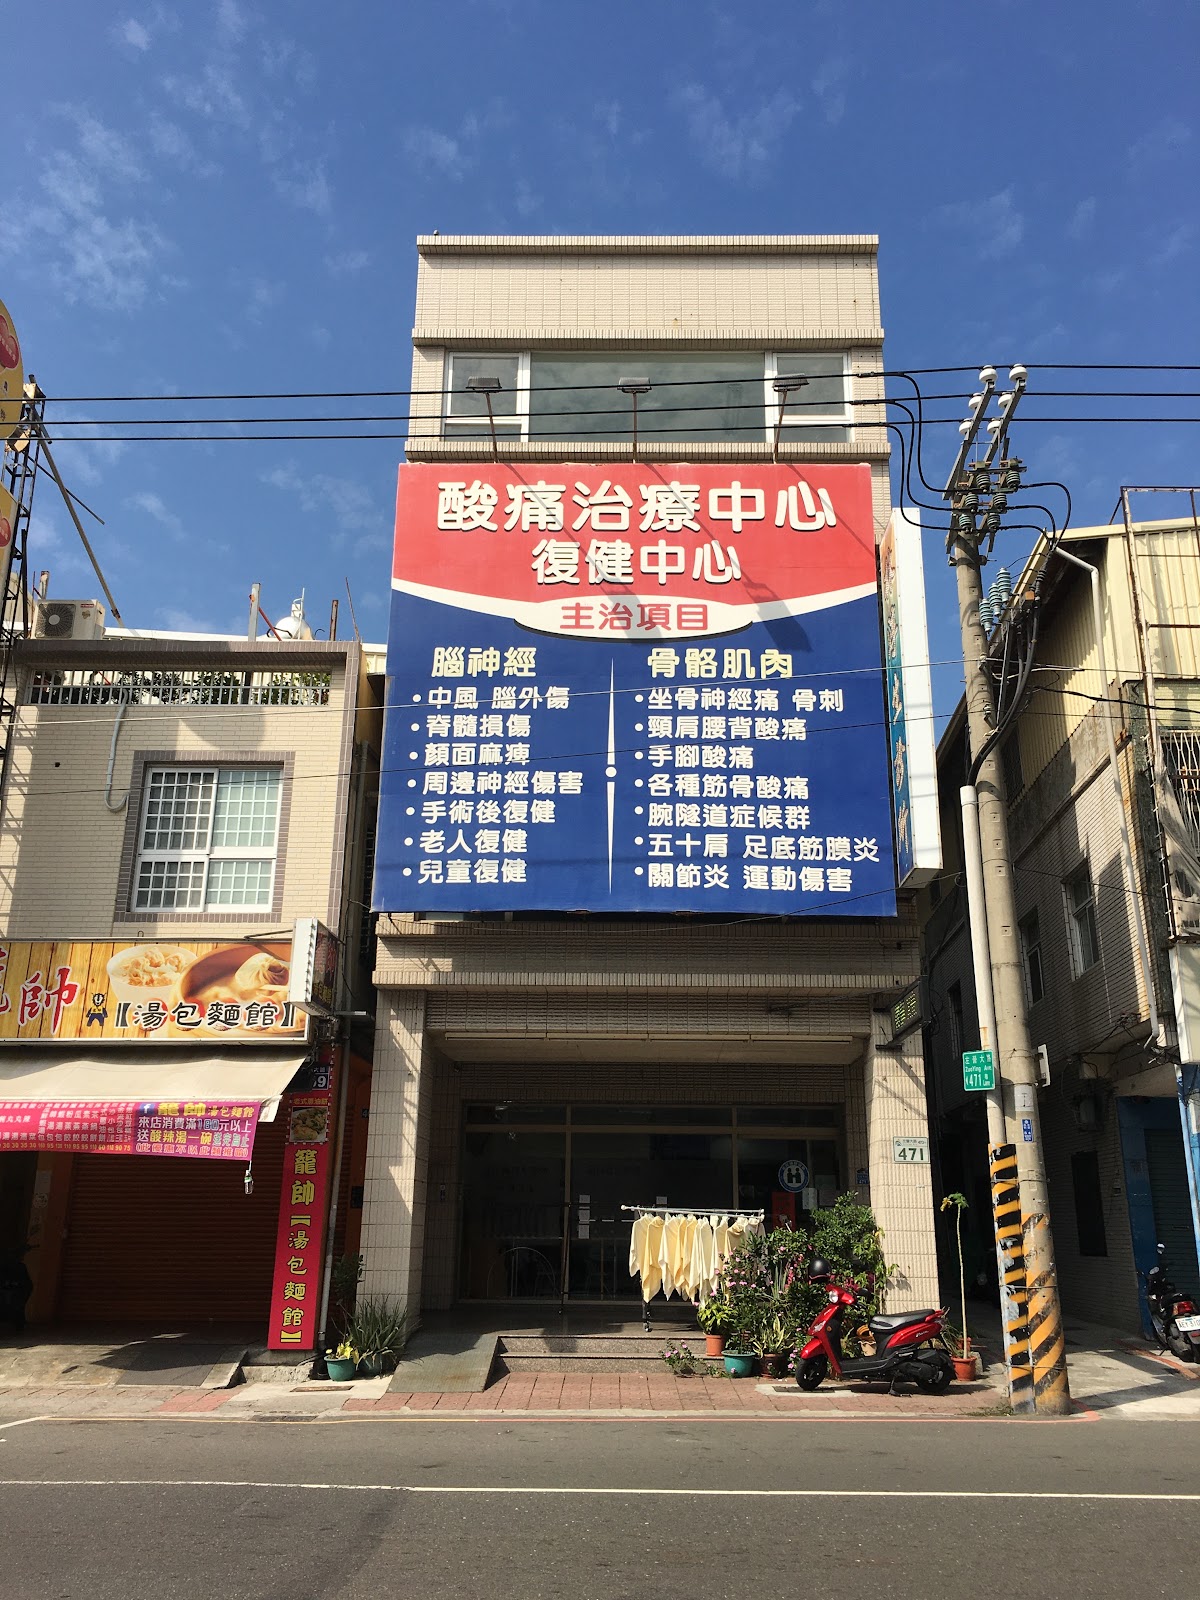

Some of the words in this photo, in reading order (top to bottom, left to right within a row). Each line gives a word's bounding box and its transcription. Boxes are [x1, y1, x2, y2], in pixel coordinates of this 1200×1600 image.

[437, 480, 838, 533] 酸痛治療中心
[531, 539, 742, 585] 復健中心
[560, 603, 708, 631] 主治項目
[431, 647, 537, 677] 腦神經
[647, 647, 793, 679] 骨骼肌肉
[428, 686, 479, 709] 中風
[491, 686, 570, 709] 腦外傷
[647, 687, 779, 711] 坐骨神經痛
[792, 689, 844, 712] 骨刺
[426, 714, 531, 737] 脊髓損傷
[647, 715, 807, 741] 頸肩腰背酸痛
[424, 742, 531, 766] 顏面麻痺
[647, 744, 754, 769] 手腳酸痛
[422, 770, 583, 795] 周邊神經傷害
[647, 773, 810, 800] 各種筋骨酸痛
[421, 799, 556, 824] 手術後復健
[647, 802, 811, 830] 腕隧道症候群
[419, 828, 528, 854] 老人復健
[647, 833, 729, 858] 五十肩
[742, 835, 880, 863] 足底筋膜炎
[417, 858, 527, 884] 兒童復健
[647, 863, 730, 889] 關節炎
[742, 864, 853, 892] 運動傷害
[969, 1074, 982, 1087] 471
[898, 1147, 924, 1161] 471
